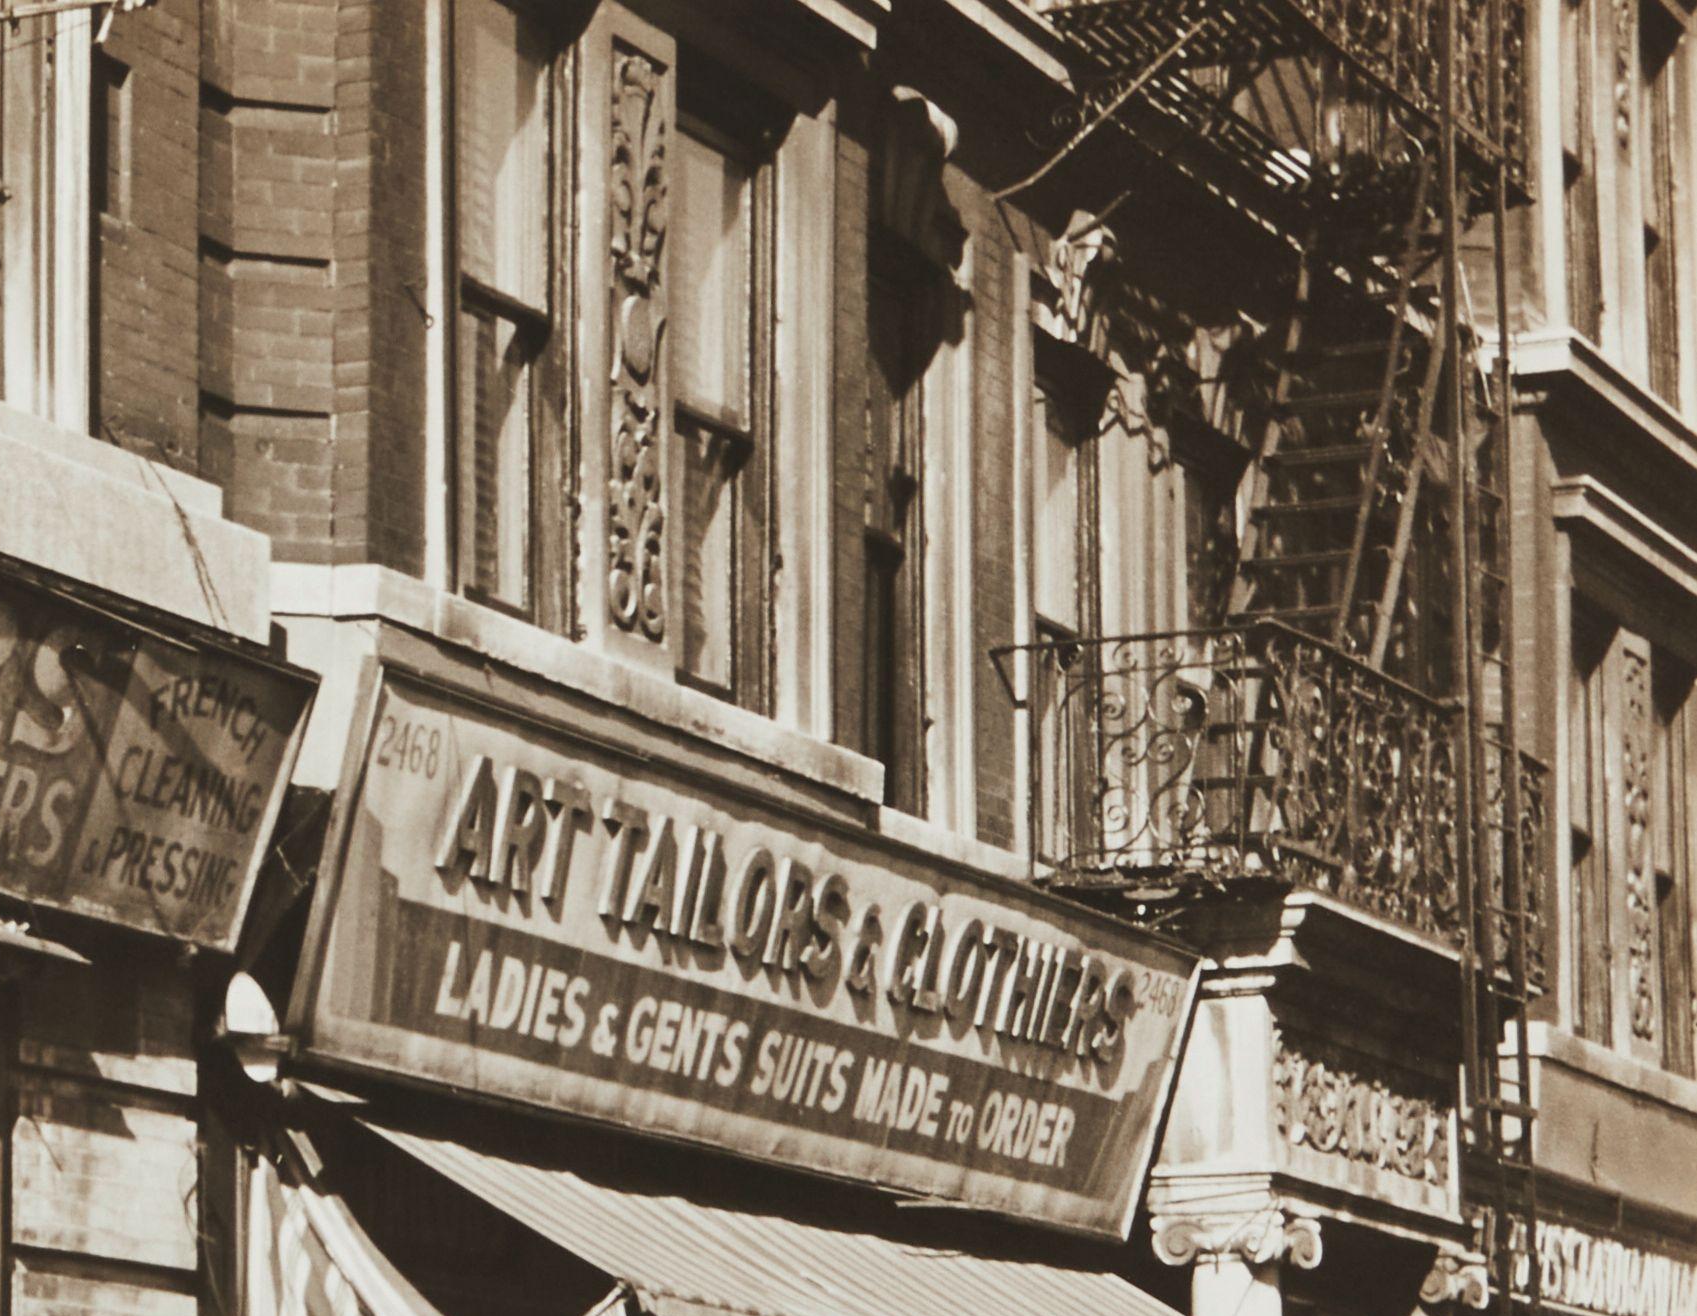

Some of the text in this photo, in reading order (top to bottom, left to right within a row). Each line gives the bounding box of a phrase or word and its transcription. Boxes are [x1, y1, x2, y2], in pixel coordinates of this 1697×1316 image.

[149, 673, 268, 765] FRENCH
[377, 716, 442, 780] 2468
[116, 746, 264, 834] CLEANING
[101, 826, 238, 907] PRESSING
[434, 754, 1136, 1060] ART TAILORS & CLOTHIERS
[435, 940, 590, 1048] LADIES
[591, 1003, 619, 1057] &
[626, 996, 750, 1087] GENTS
[751, 1030, 855, 1113] SUITS
[853, 1056, 950, 1138] MADE
[978, 1091, 1076, 1168] ORDER
